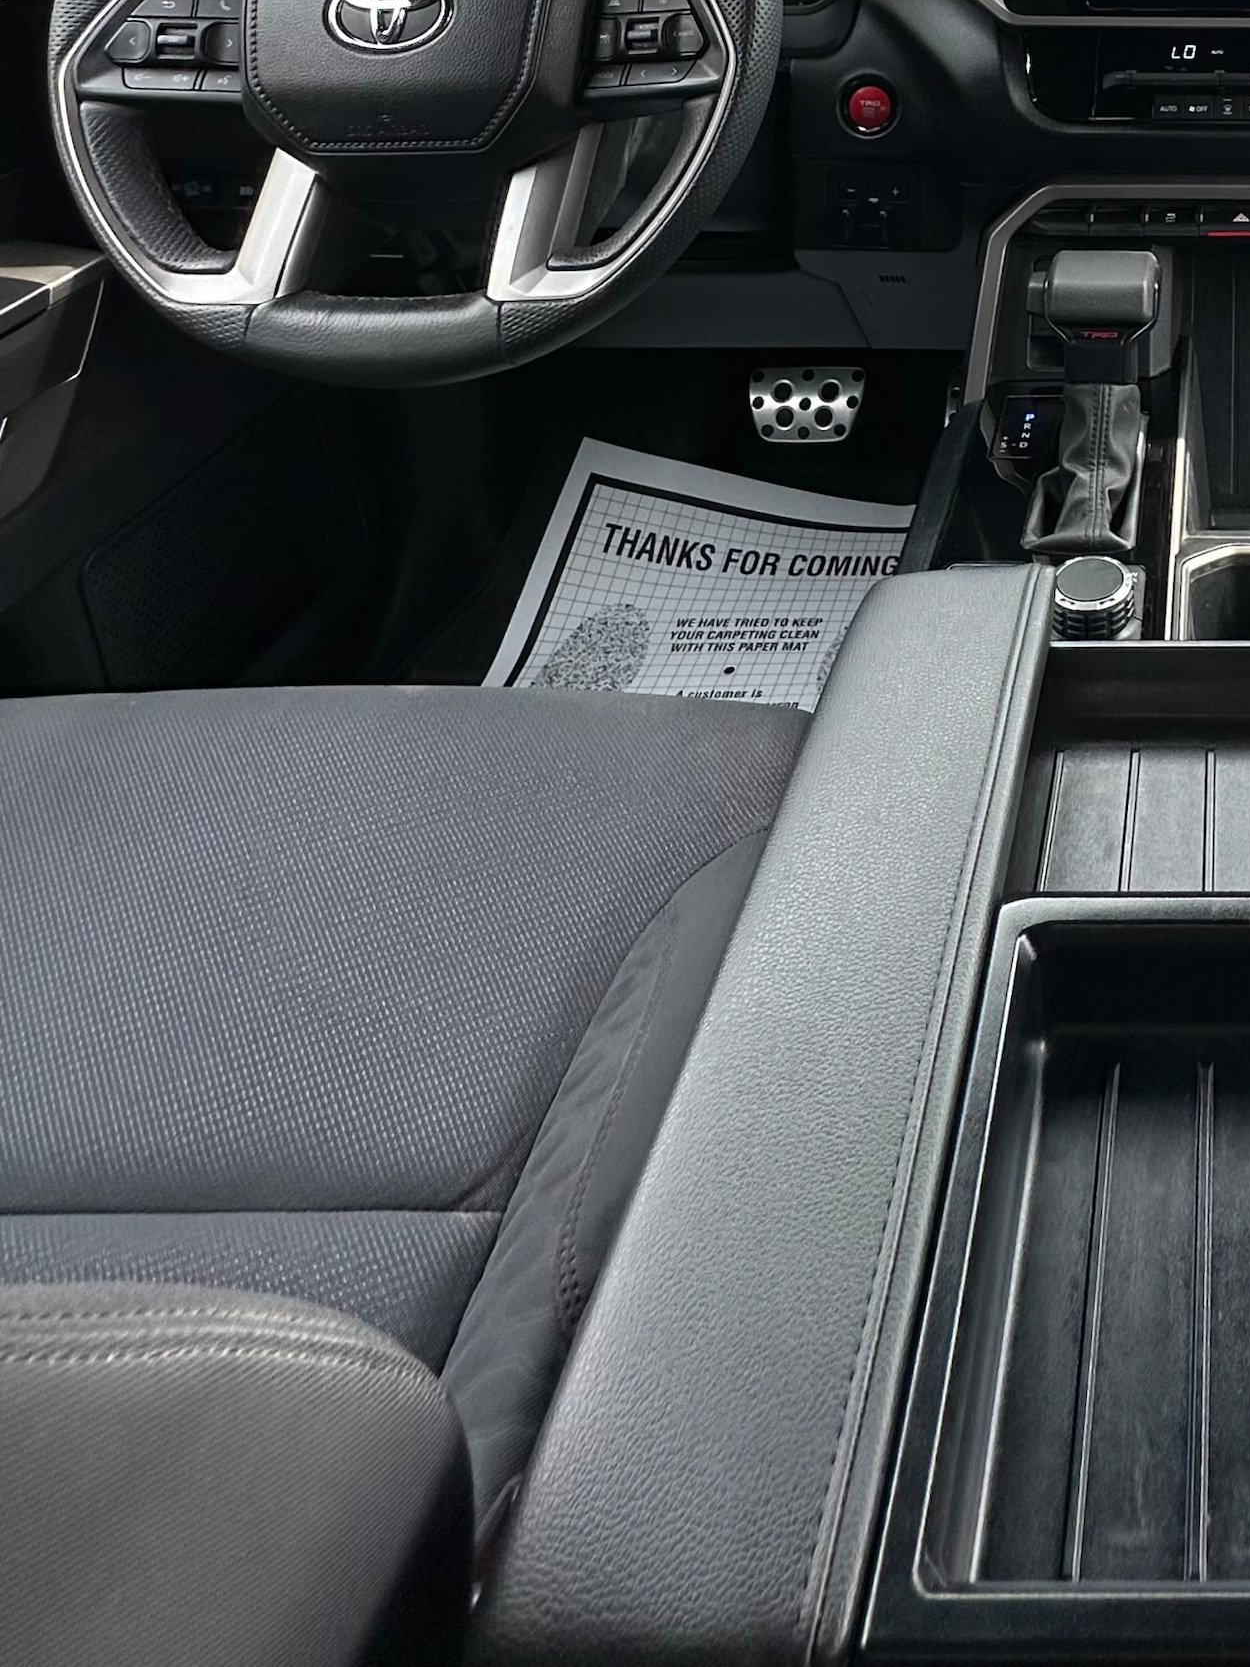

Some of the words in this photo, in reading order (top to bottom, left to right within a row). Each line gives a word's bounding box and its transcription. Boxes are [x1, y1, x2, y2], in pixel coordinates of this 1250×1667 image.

[1171, 44, 1197, 60] LO
[859, 99, 881, 107] TRD
[1159, 105, 1178, 113] AUTO
[1196, 105, 1208, 113] OFF
[1080, 331, 1118, 339] TRD
[1025, 413, 1035, 421] P
[1023, 422, 1031, 430] R
[601, 522, 716, 572] THANKS
[722, 548, 781, 577] FOR
[788, 554, 901, 578] COMING
[676, 618, 697, 628] WE
[698, 618, 731, 628] HAVE
[734, 618, 770, 628] TRIED
[774, 618, 788, 627] TO
[792, 618, 823, 627] KEEP
[670, 630, 704, 640] YOUR
[706, 630, 776, 640] CARPETING
[779, 630, 820, 639] CLEAN
[671, 642, 705, 653] WITH
[707, 642, 735, 652] THIS
[738, 642, 778, 652] PAPER
[782, 641, 809, 651] MAT
[687, 689, 748, 699] customer
[750, 688, 764, 698] is
